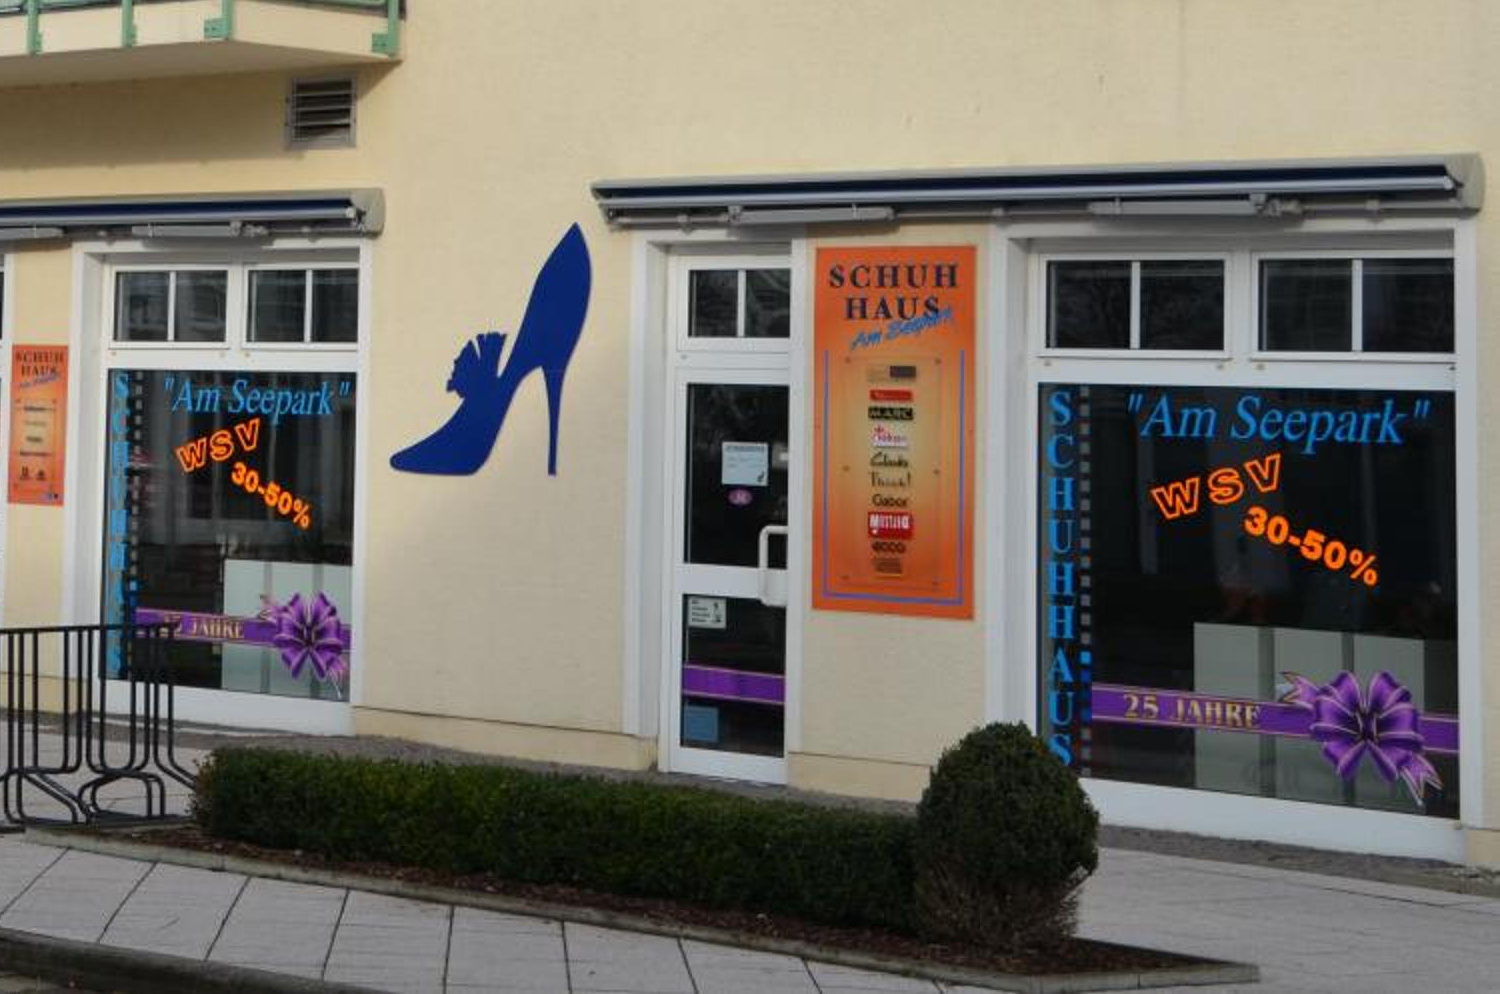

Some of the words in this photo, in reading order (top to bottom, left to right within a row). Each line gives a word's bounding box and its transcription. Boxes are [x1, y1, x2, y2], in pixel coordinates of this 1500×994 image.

[829, 262, 959, 289] SCHUH
[844, 295, 940, 321] HAUS
[164, 377, 221, 413] "Am
[1127, 392, 1218, 438] "Am
[176, 417, 261, 473] WSV
[231, 461, 311, 529] 30-50%
[1151, 452, 1282, 520] WSV
[1244, 505, 1379, 586] 30-50%
[1046, 390, 1075, 767] SCHUHHAUS
[1123, 693, 1160, 719] 25
[1170, 698, 1262, 729] JAHRE
